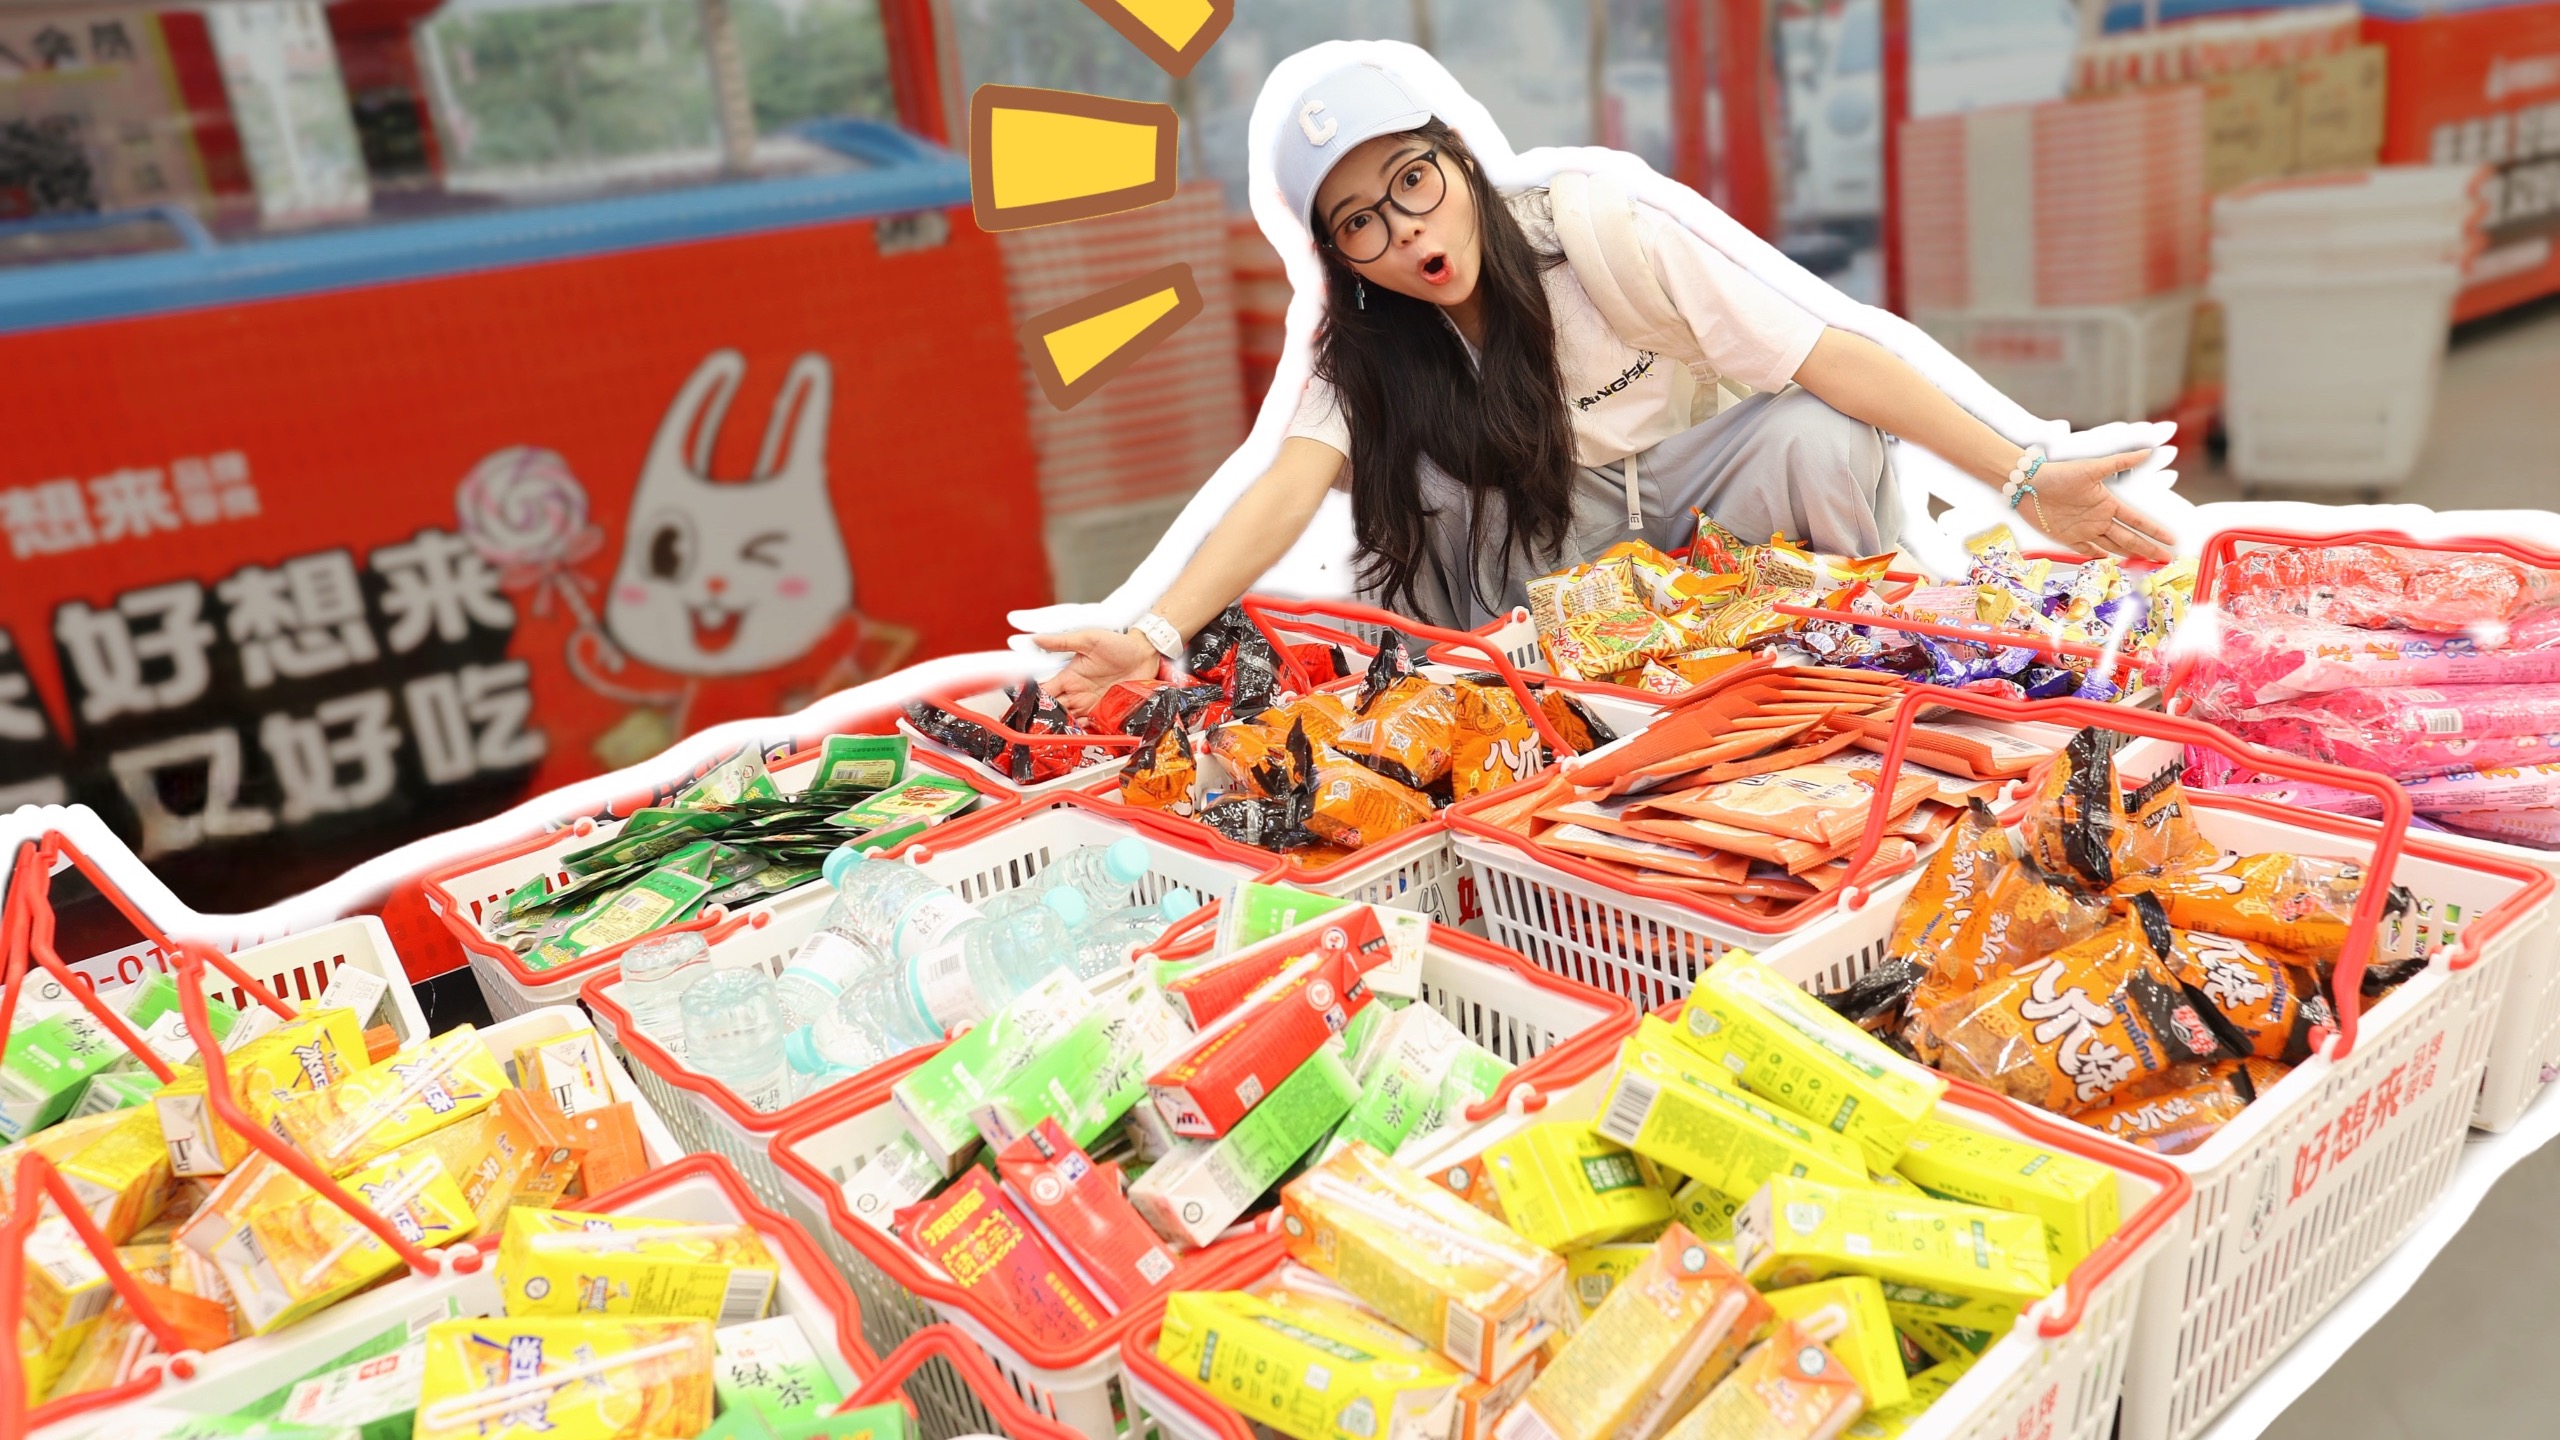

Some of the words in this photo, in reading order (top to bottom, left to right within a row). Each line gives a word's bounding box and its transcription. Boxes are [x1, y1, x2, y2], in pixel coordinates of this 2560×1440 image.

[1298, 99, 1338, 147] C
[52, 526, 517, 724] 好想来
[107, 660, 549, 862] 又好吃
[2009, 958, 2137, 1103] 八爪烧
[2287, 1060, 2408, 1207] 好想来
